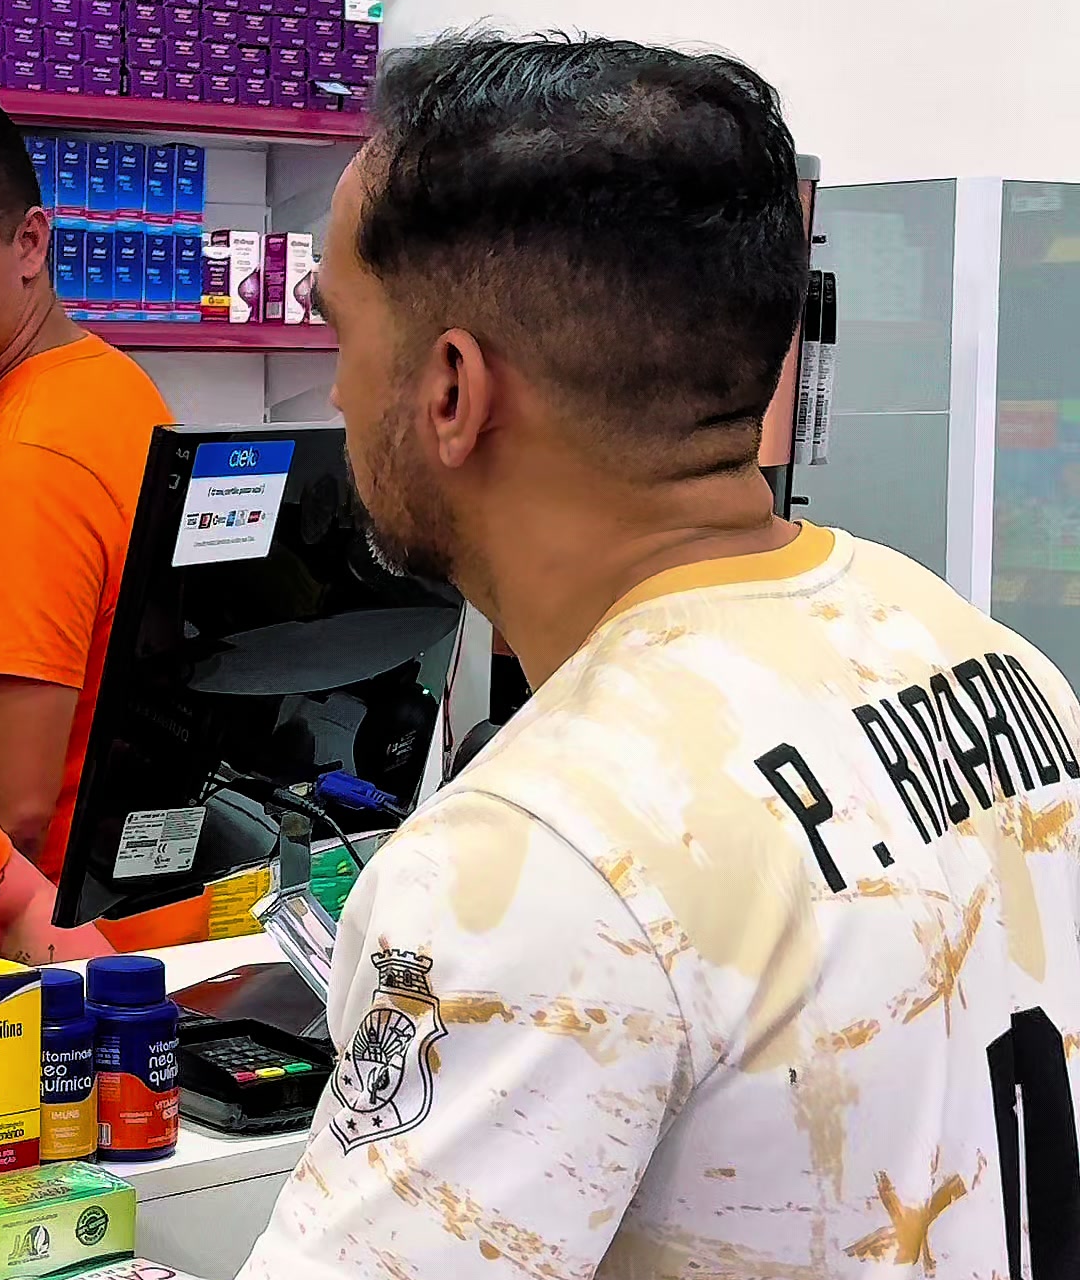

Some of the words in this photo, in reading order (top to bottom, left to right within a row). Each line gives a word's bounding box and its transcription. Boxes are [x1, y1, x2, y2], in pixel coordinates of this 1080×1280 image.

[42, 1048, 92, 1062] itaminas
[149, 1052, 173, 1068] neo
[41, 1065, 67, 1076] eo
